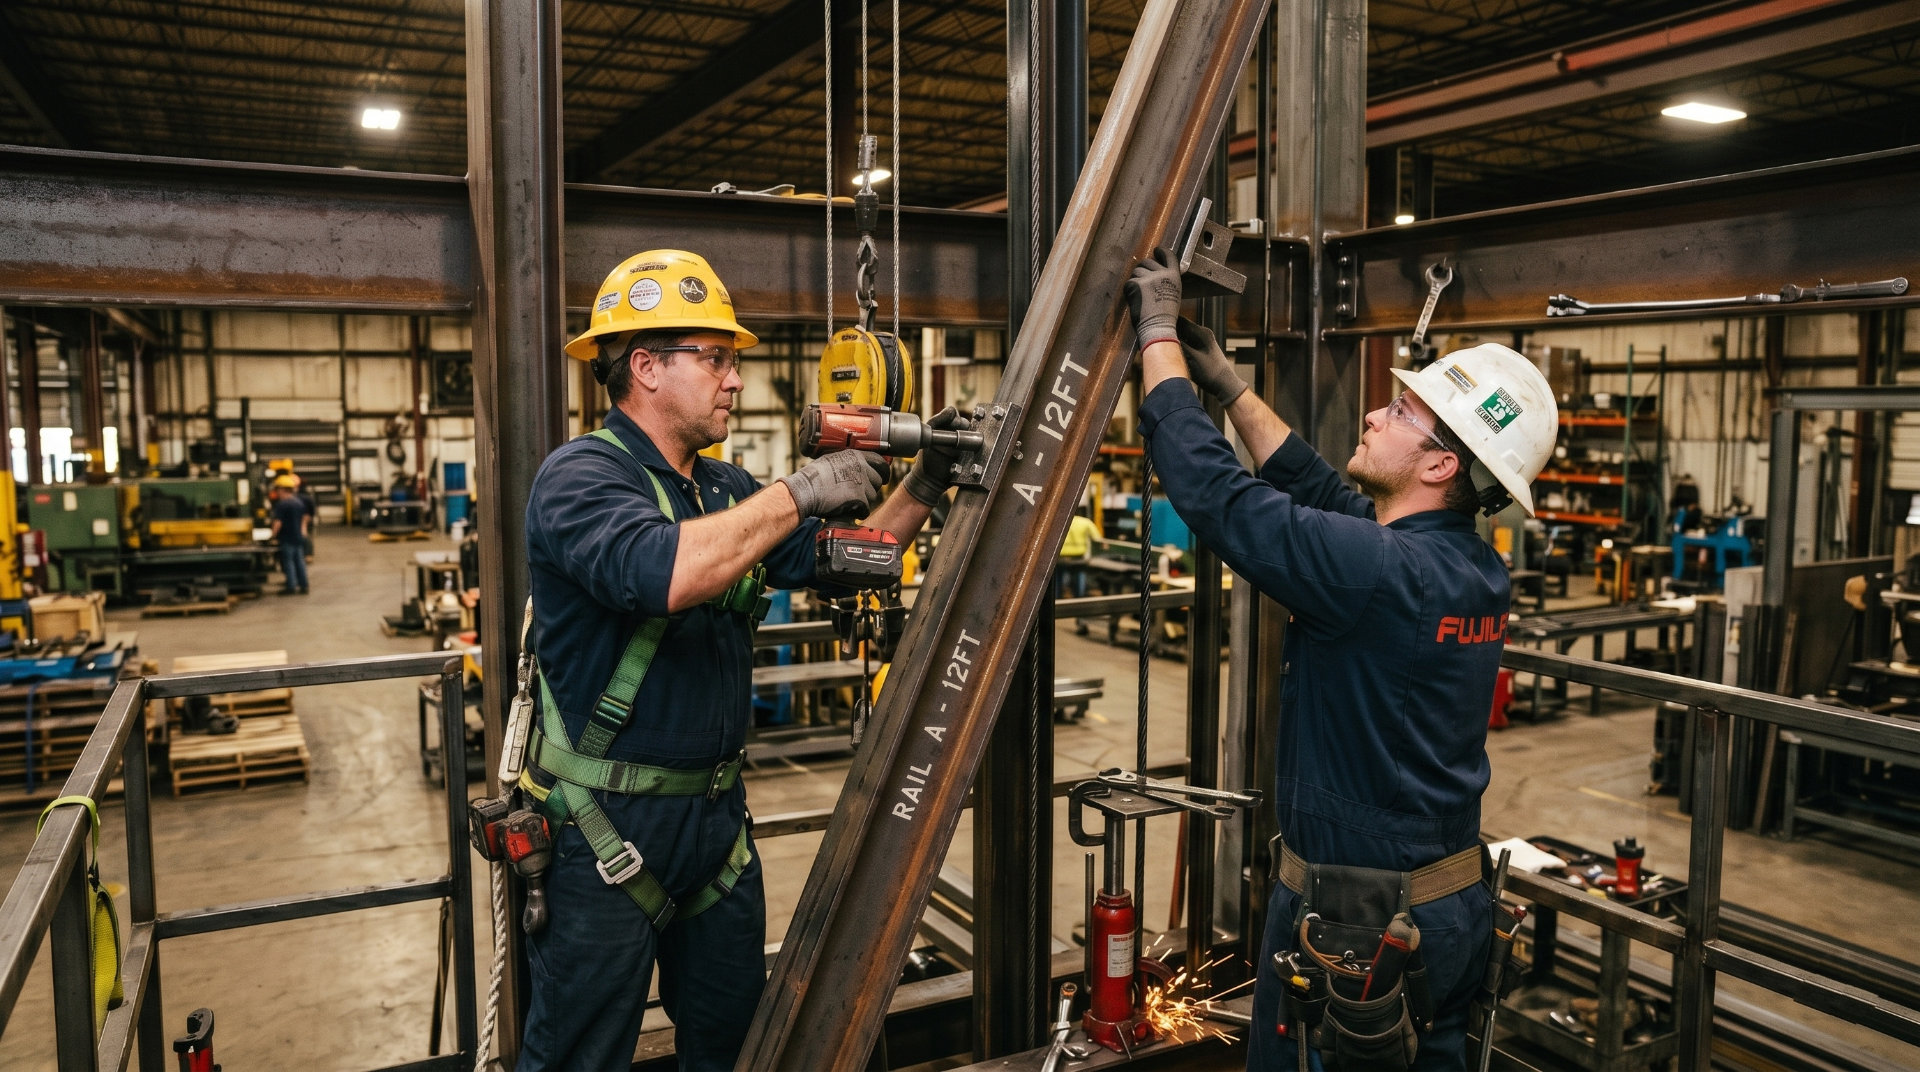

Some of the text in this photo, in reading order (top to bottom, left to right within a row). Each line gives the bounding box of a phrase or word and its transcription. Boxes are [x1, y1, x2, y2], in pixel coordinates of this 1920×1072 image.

[1012, 352, 1090, 506] A - 12FT
[892, 763, 933, 821] RAIL
[924, 726, 947, 743] A
[942, 629, 981, 692] 12FT
